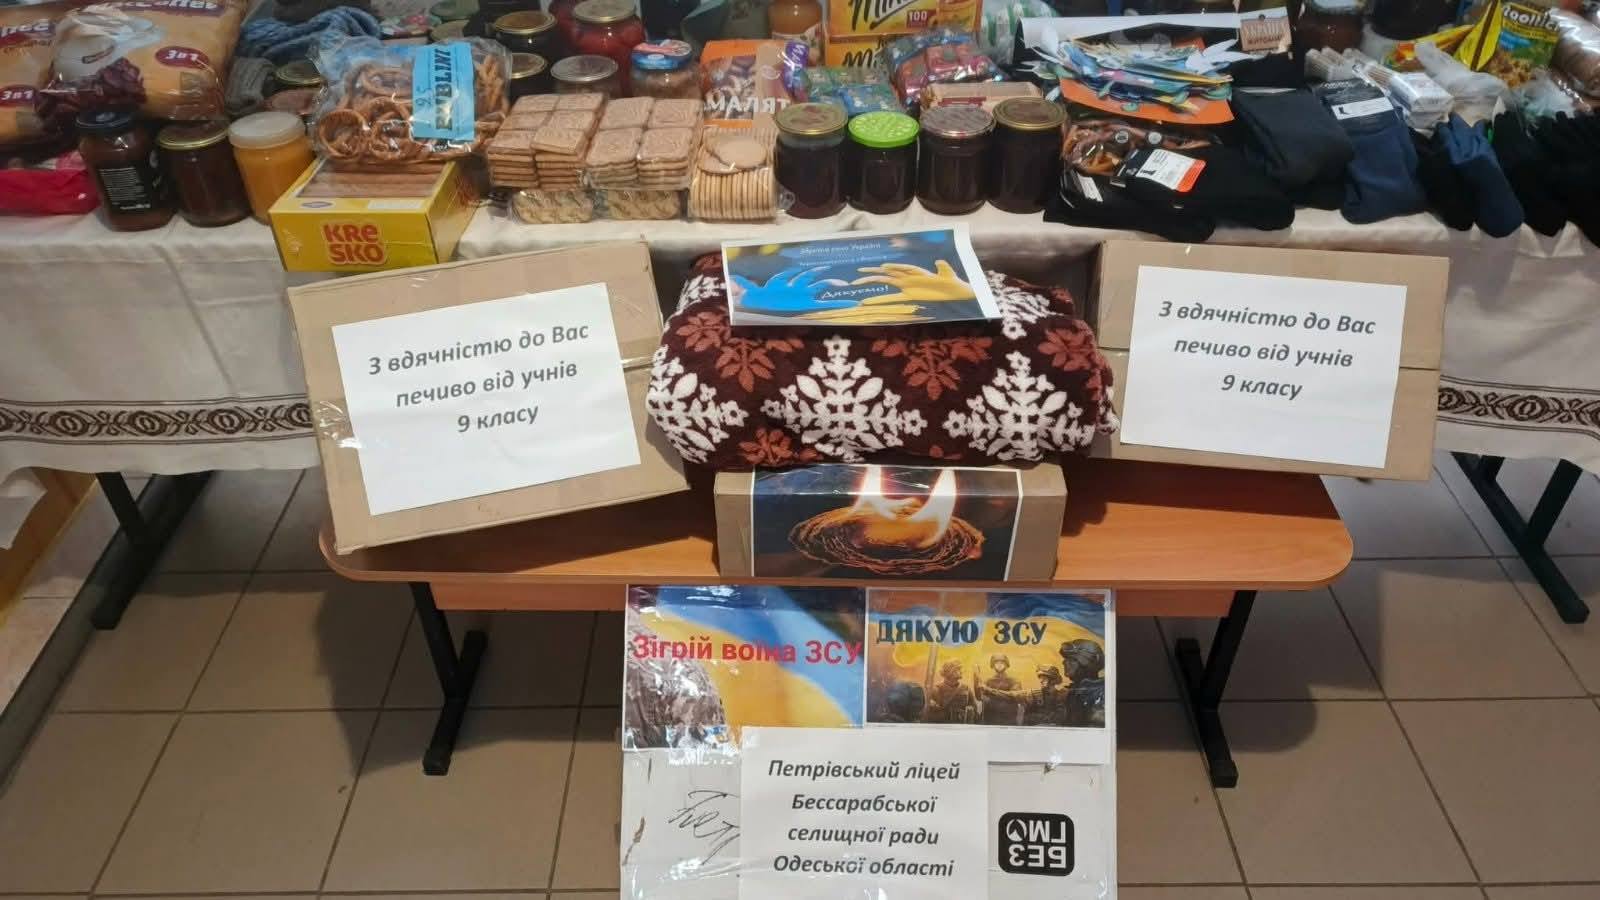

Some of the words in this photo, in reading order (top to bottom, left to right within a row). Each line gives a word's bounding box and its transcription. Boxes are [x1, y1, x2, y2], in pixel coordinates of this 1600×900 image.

[908, 10, 928, 22] 100
[1177, 303, 1297, 328] вдячністю
[1303, 312, 1330, 330] до
[1336, 316, 1376, 334] Вас
[388, 338, 512, 371] вдячністю
[518, 330, 545, 348] до
[552, 324, 589, 343] Вас
[1173, 339, 1251, 358] печиво
[1257, 344, 1290, 361] від
[1296, 350, 1353, 367] учнів
[396, 382, 476, 407] печиво
[483, 370, 515, 393] від
[522, 360, 578, 389] учнів
[1221, 374, 1236, 392] 9
[1240, 379, 1303, 400] класу
[457, 415, 470, 433] 9
[477, 404, 540, 430] класу
[876, 619, 979, 645] ДЯКУЮ
[993, 621, 1047, 645] ЗСУ
[632, 634, 712, 661] Зігрій
[805, 640, 862, 664] ЗСУ
[768, 759, 900, 781] Петрівський
[904, 762, 960, 783] ліцей
[791, 793, 938, 814] Бессарабської
[787, 826, 886, 846] селищної
[888, 827, 939, 847] ради
[1006, 818, 1067, 843] ГМО
[773, 855, 867, 873] Одеської
[869, 858, 955, 877] області
[1006, 843, 1067, 869] БЕЗ
